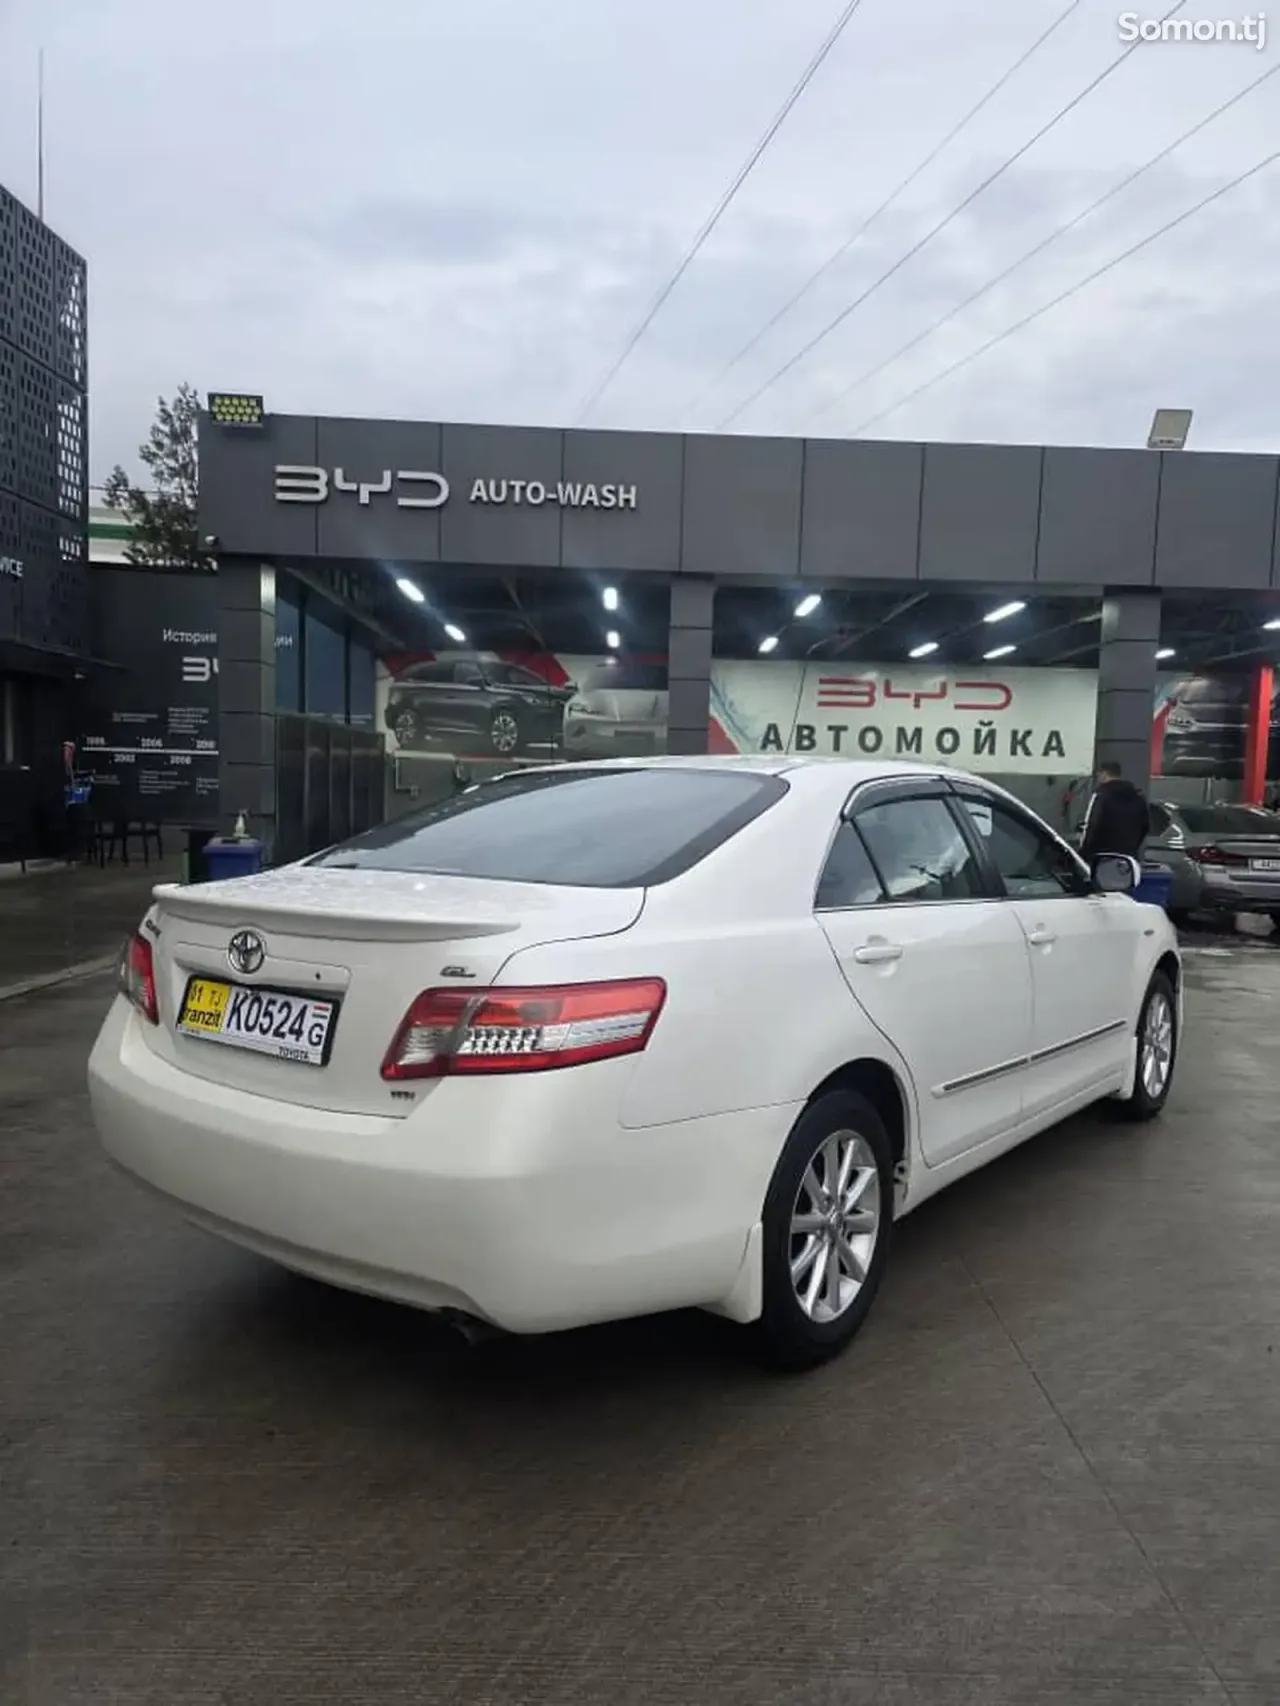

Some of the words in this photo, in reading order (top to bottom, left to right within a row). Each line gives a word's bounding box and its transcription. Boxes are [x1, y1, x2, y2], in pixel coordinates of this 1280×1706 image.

[275, 464, 449, 507] BYD
[470, 478, 637, 509] AUTO-WASH
[817, 676, 1012, 711] BYD
[760, 719, 1066, 757] АВТОМОЙКА
[183, 1008, 221, 1027] ranzit
